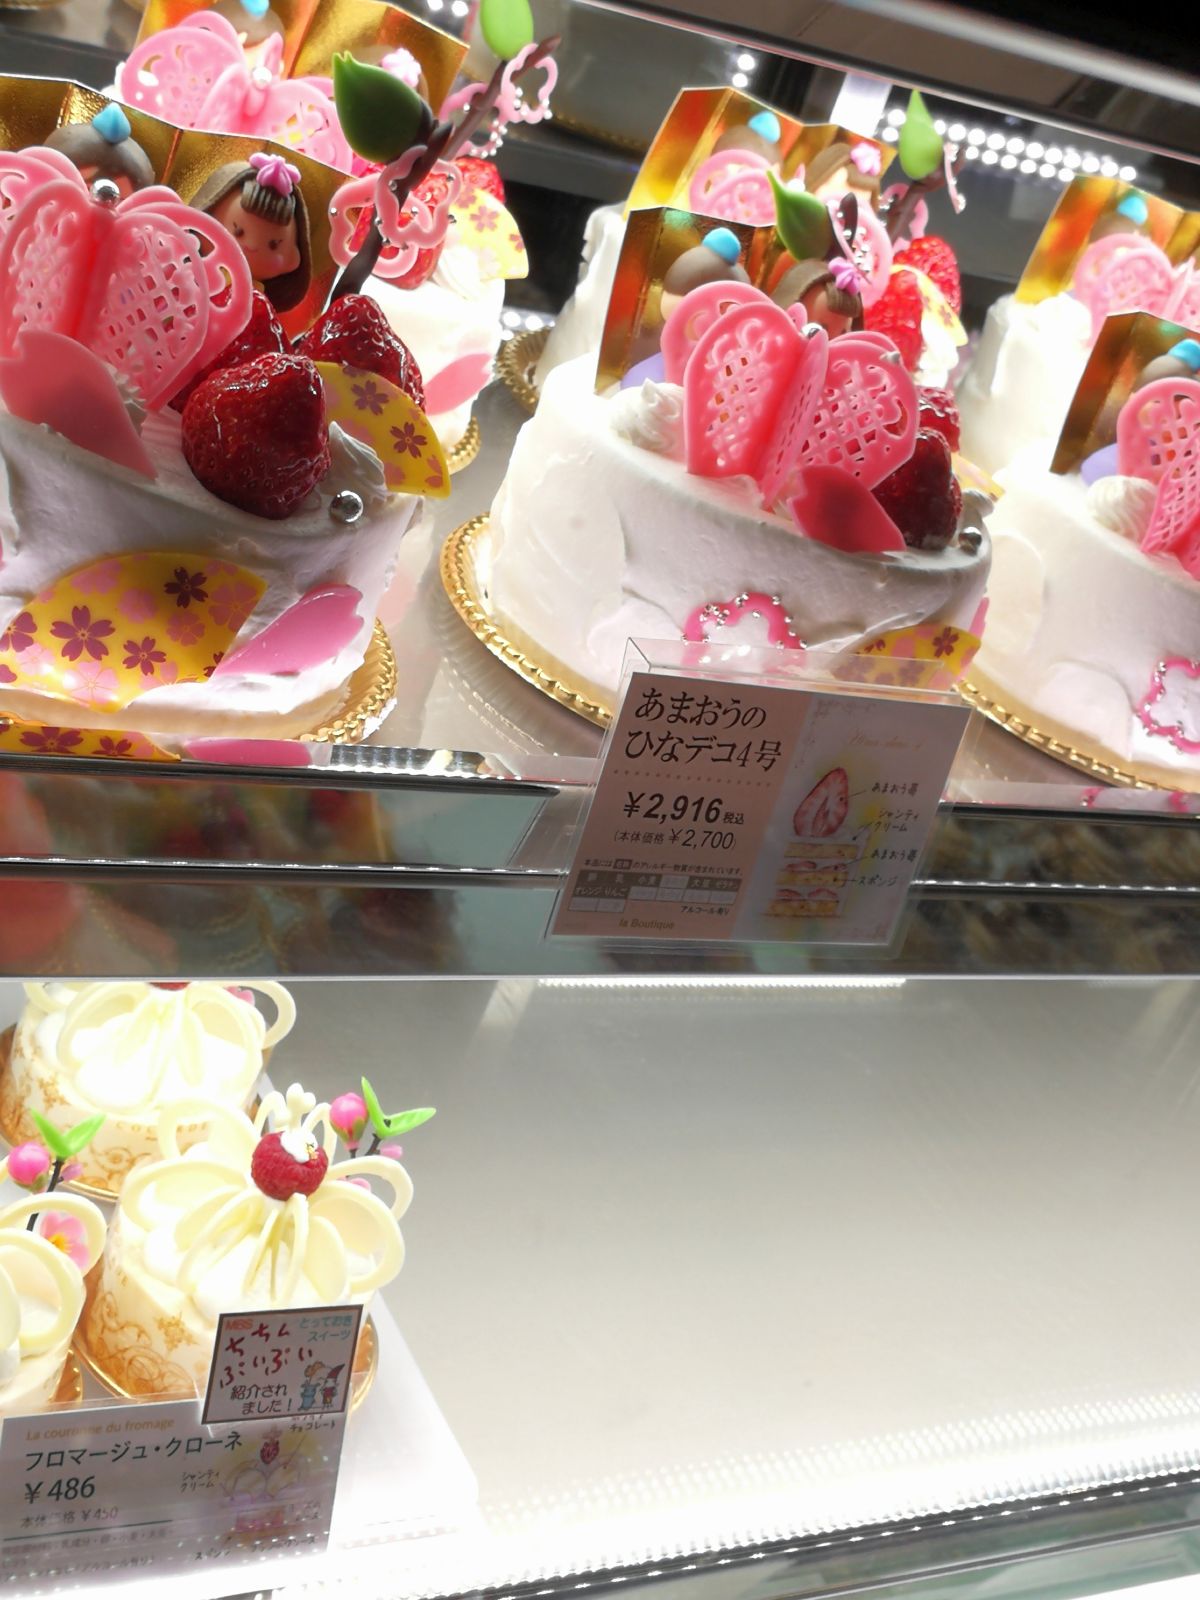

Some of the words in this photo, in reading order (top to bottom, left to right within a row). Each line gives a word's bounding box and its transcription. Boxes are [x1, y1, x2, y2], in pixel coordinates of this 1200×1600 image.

[635, 686, 767, 729] あまおうの
[625, 729, 782, 772] ひなデコ4号
[623, 791, 723, 824] ¥2,916
[630, 918, 676, 931] Boutique
[299, 1314, 354, 1330] とっておき
[307, 1328, 352, 1343] スイーツ
[230, 1383, 288, 1401] 紹介され
[25, 1428, 40, 1441] La
[106, 1420, 122, 1433] du
[125, 1417, 175, 1433] fromage
[25, 1430, 243, 1472] フロマージュ・クローネ
